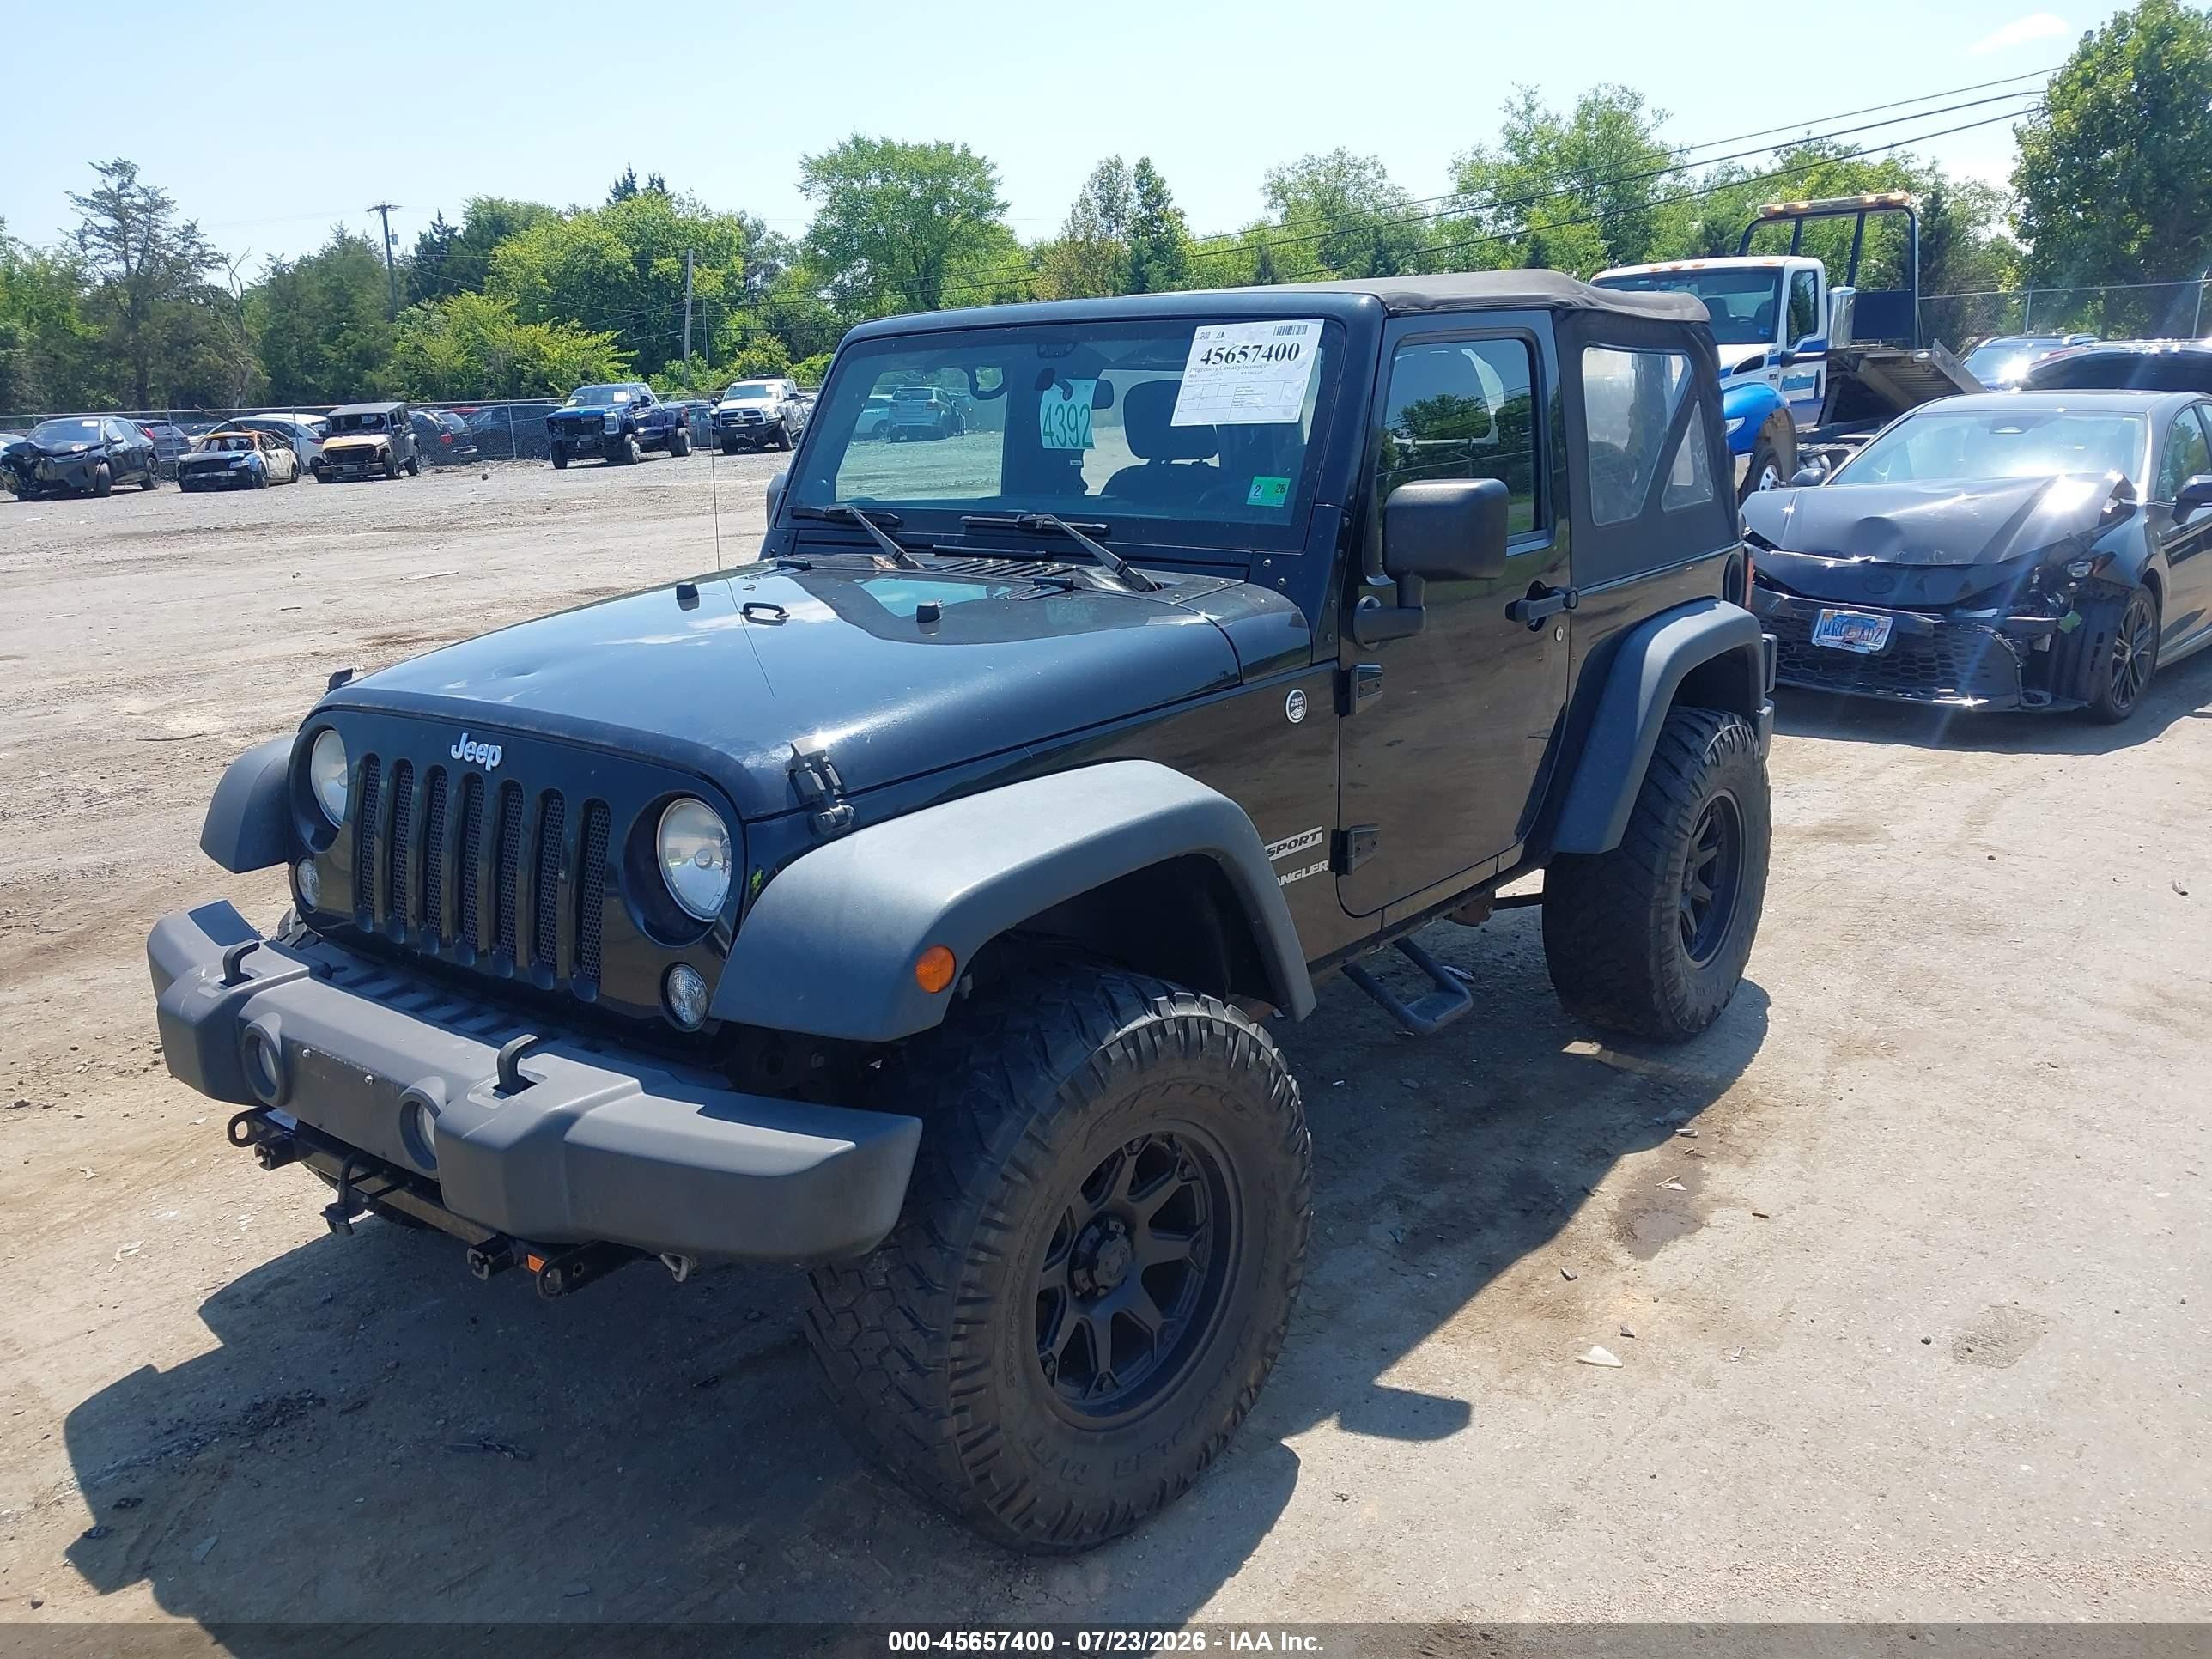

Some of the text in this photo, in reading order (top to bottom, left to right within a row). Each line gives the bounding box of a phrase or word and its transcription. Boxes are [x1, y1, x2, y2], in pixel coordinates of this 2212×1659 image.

[1200, 343, 1300, 365] 45657400
[1042, 404, 1094, 447] 4392
[1254, 484, 1261, 497] 2
[451, 732, 502, 771] Jeep
[1267, 831, 1322, 857] SPORT
[1277, 860, 1329, 886] NGLER
